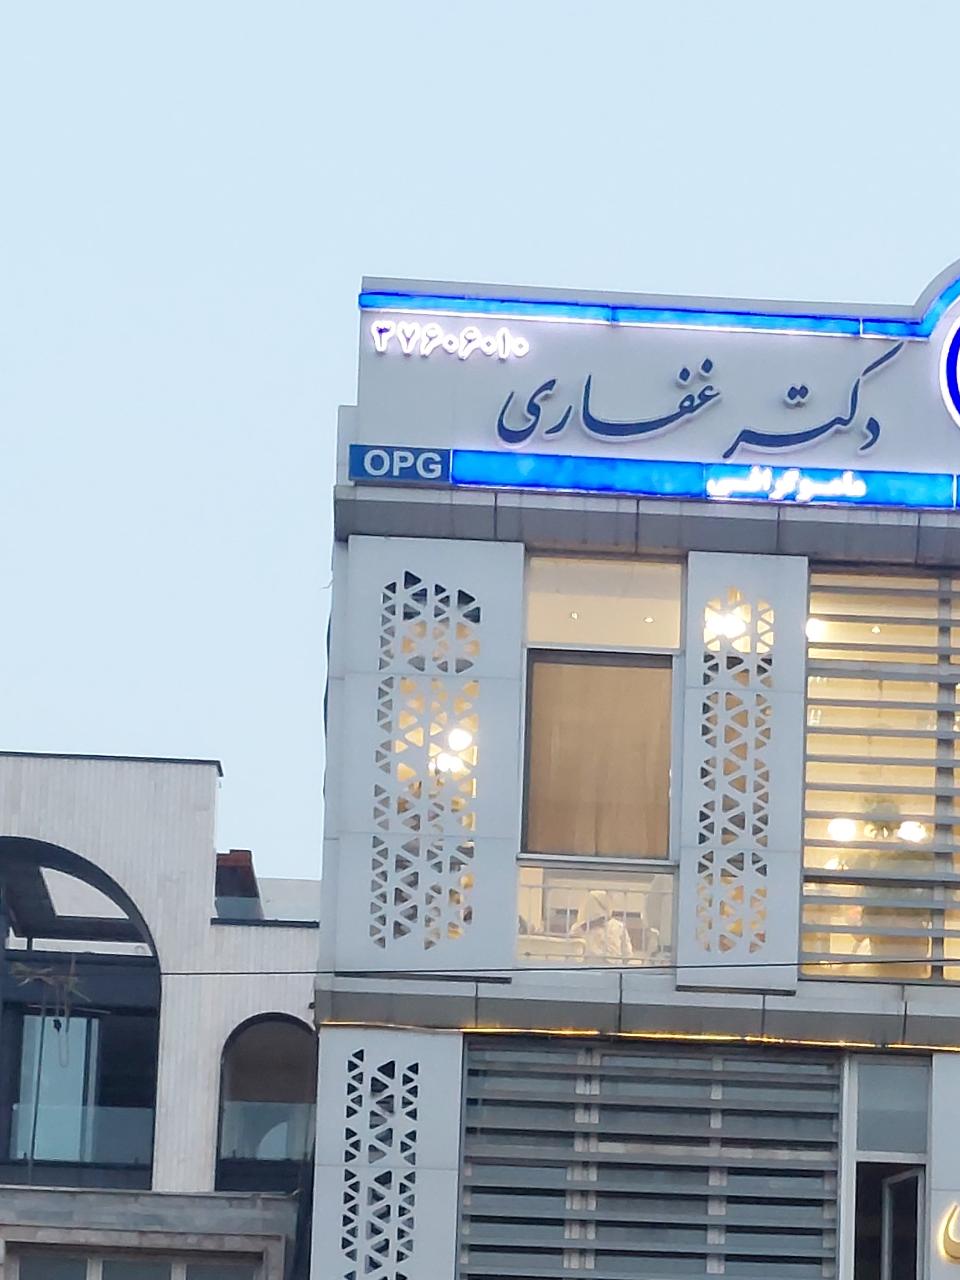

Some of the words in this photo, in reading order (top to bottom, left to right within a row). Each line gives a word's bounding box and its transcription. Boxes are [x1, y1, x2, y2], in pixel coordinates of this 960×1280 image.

[495, 356, 722, 446] غفاری
[722, 341, 906, 459] دکتر
[363, 449, 442, 479] OPG
